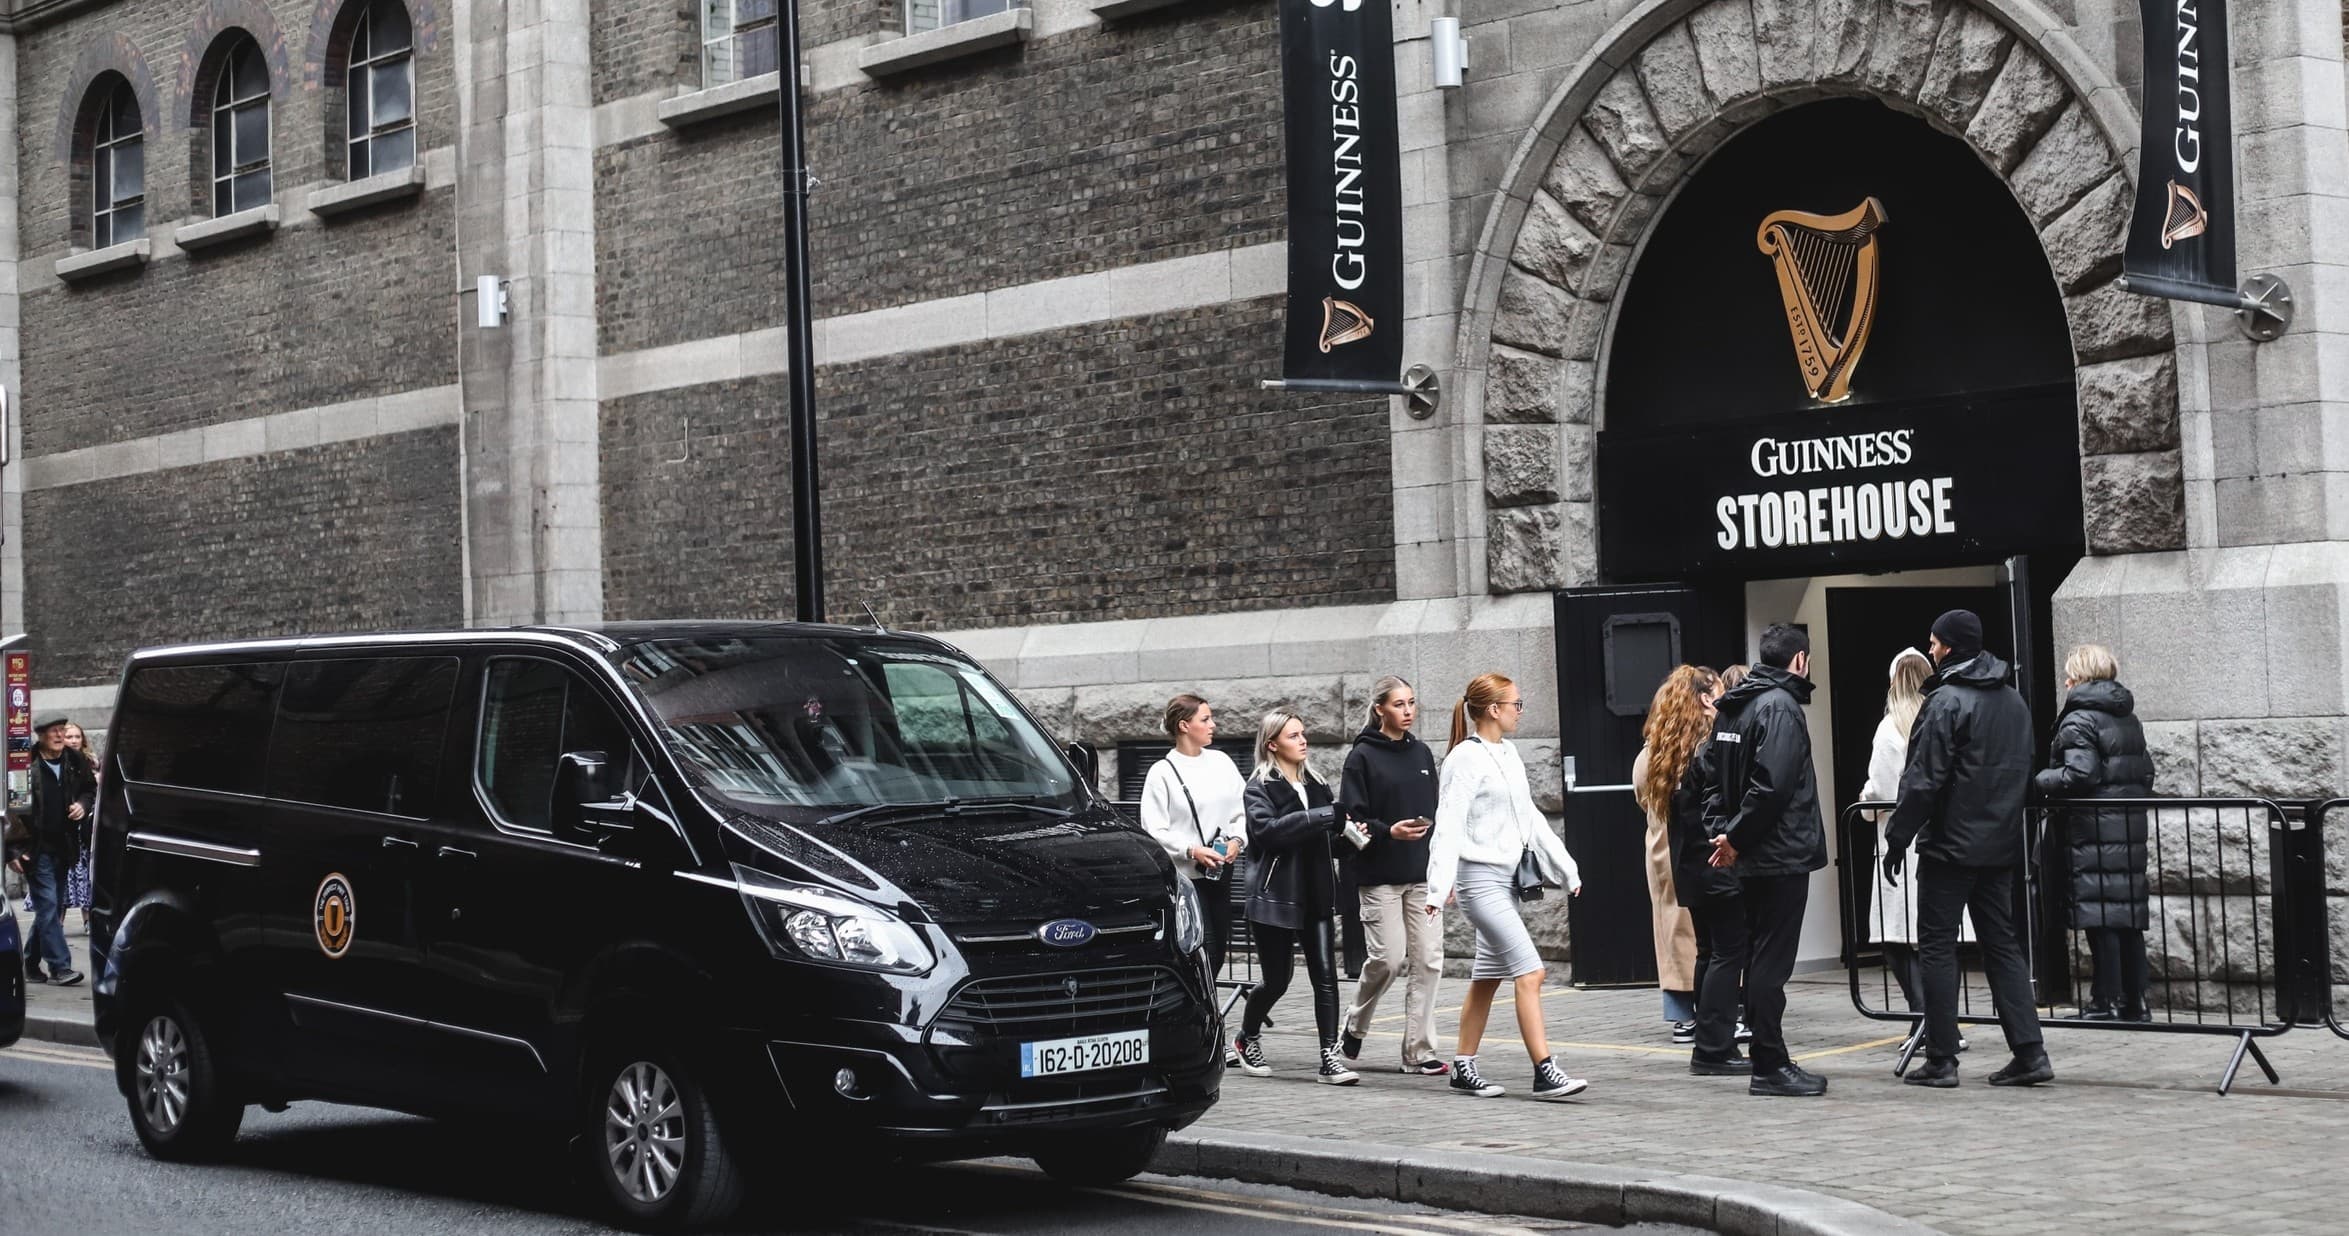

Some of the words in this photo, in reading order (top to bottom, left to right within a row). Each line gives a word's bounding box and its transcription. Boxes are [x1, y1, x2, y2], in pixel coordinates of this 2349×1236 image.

[1330, 54, 1366, 290] GUINNESS
[1799, 339, 1819, 376] 1759
[1750, 430, 1913, 477] GUINNESS
[1716, 477, 1955, 550] STOREHOUSE
[1054, 924, 1085, 940] Ford
[1040, 1038, 1142, 1073] 162-D-20208
